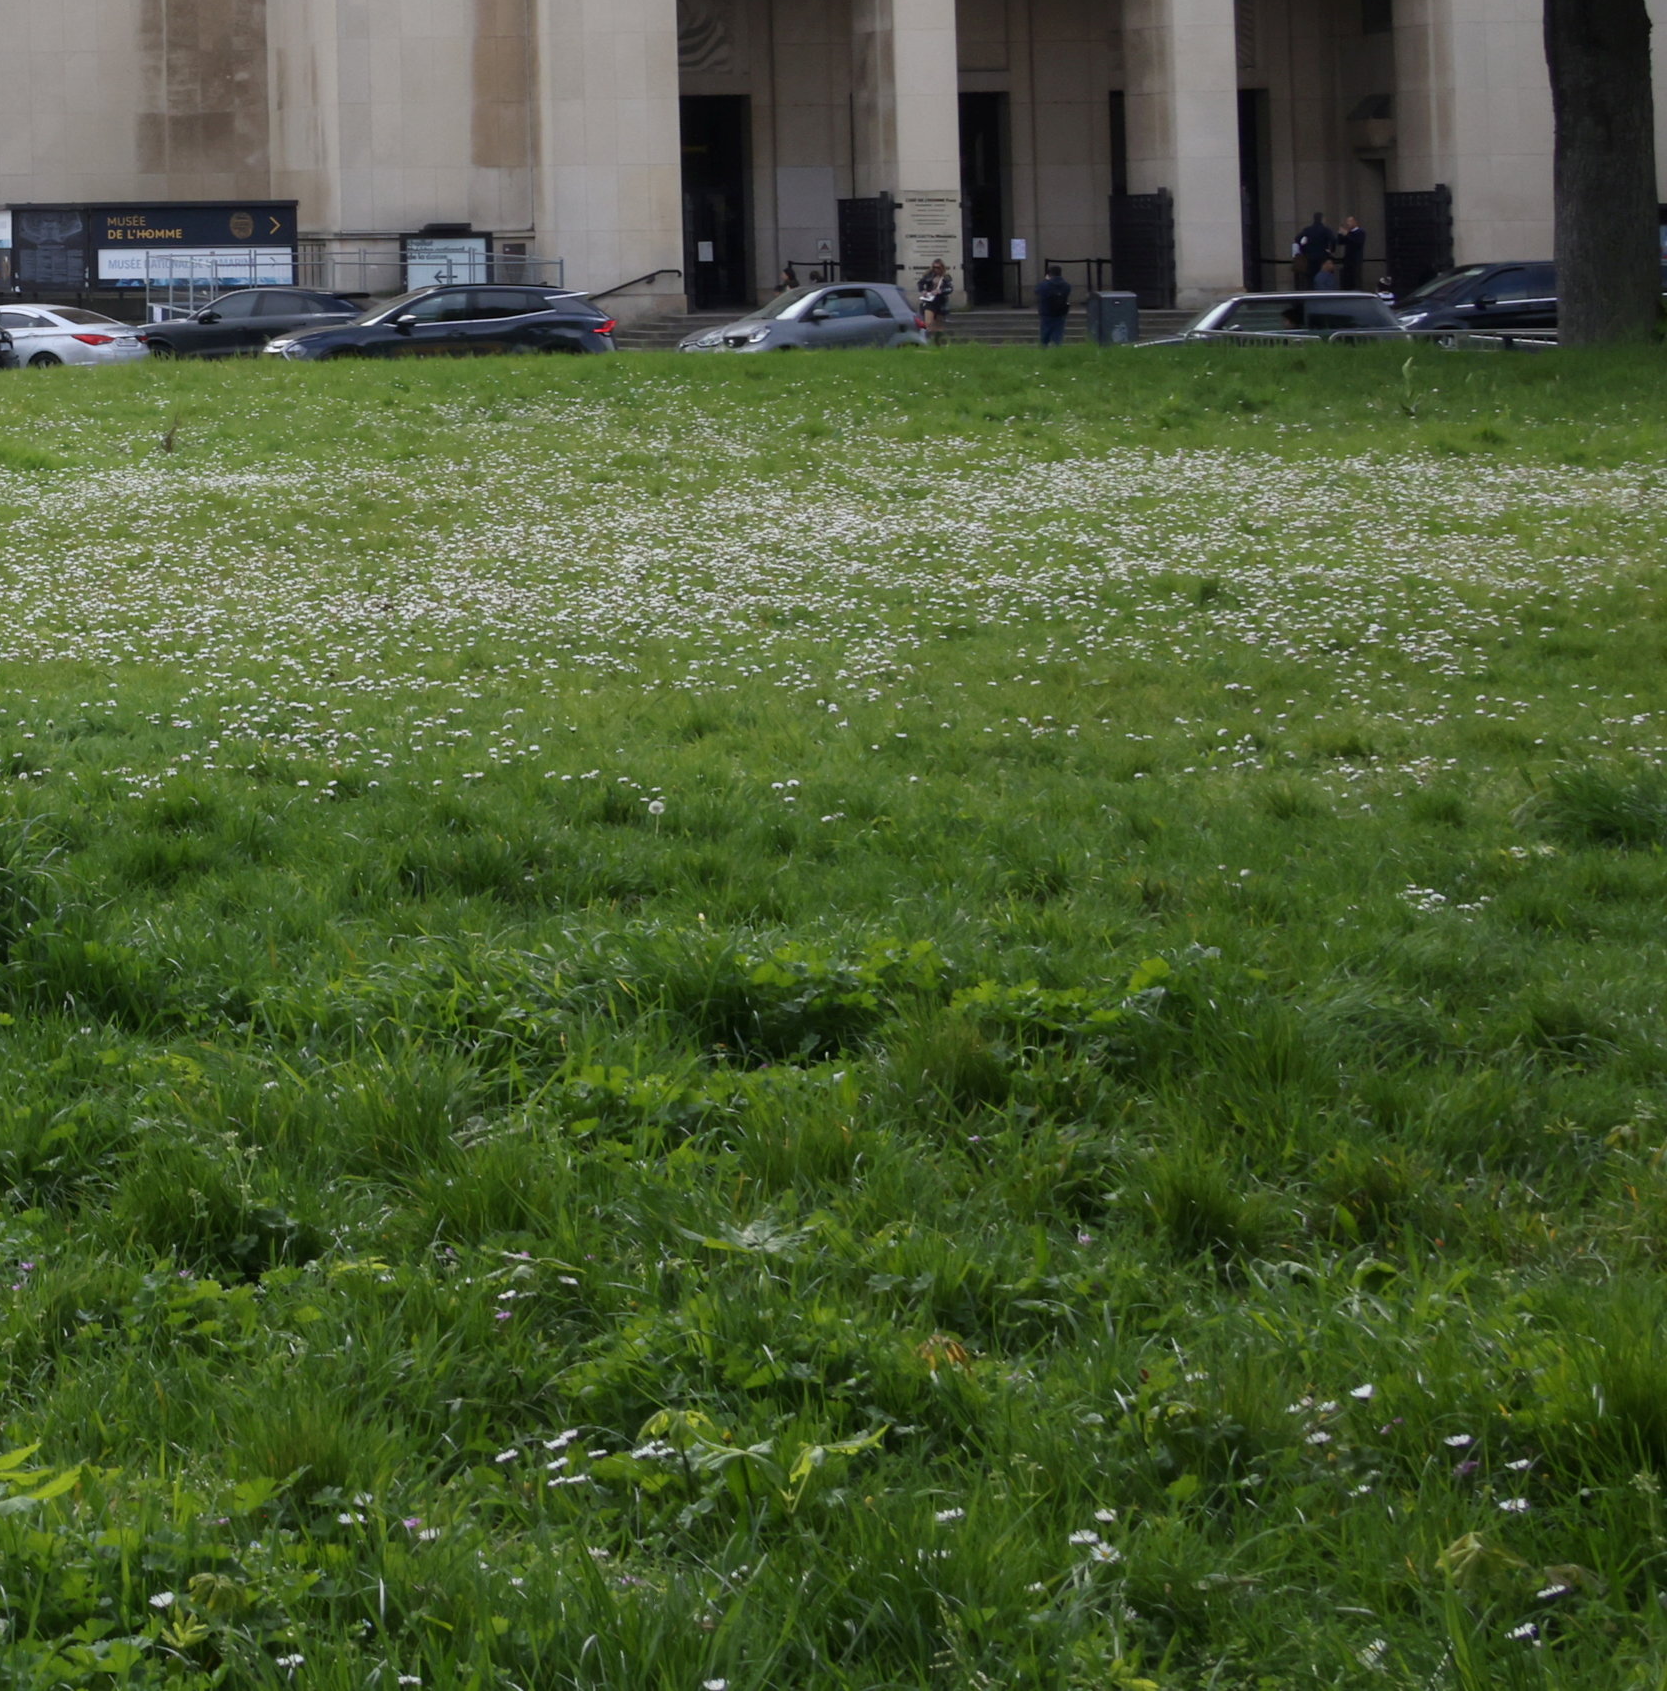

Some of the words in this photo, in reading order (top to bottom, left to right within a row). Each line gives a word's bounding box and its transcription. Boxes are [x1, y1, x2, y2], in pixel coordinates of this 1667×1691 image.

[107, 215, 147, 227] MUSÉE
[107, 229, 124, 240] DE
[126, 228, 183, 240] L'HOMME
[107, 257, 142, 270] MUSÉE
